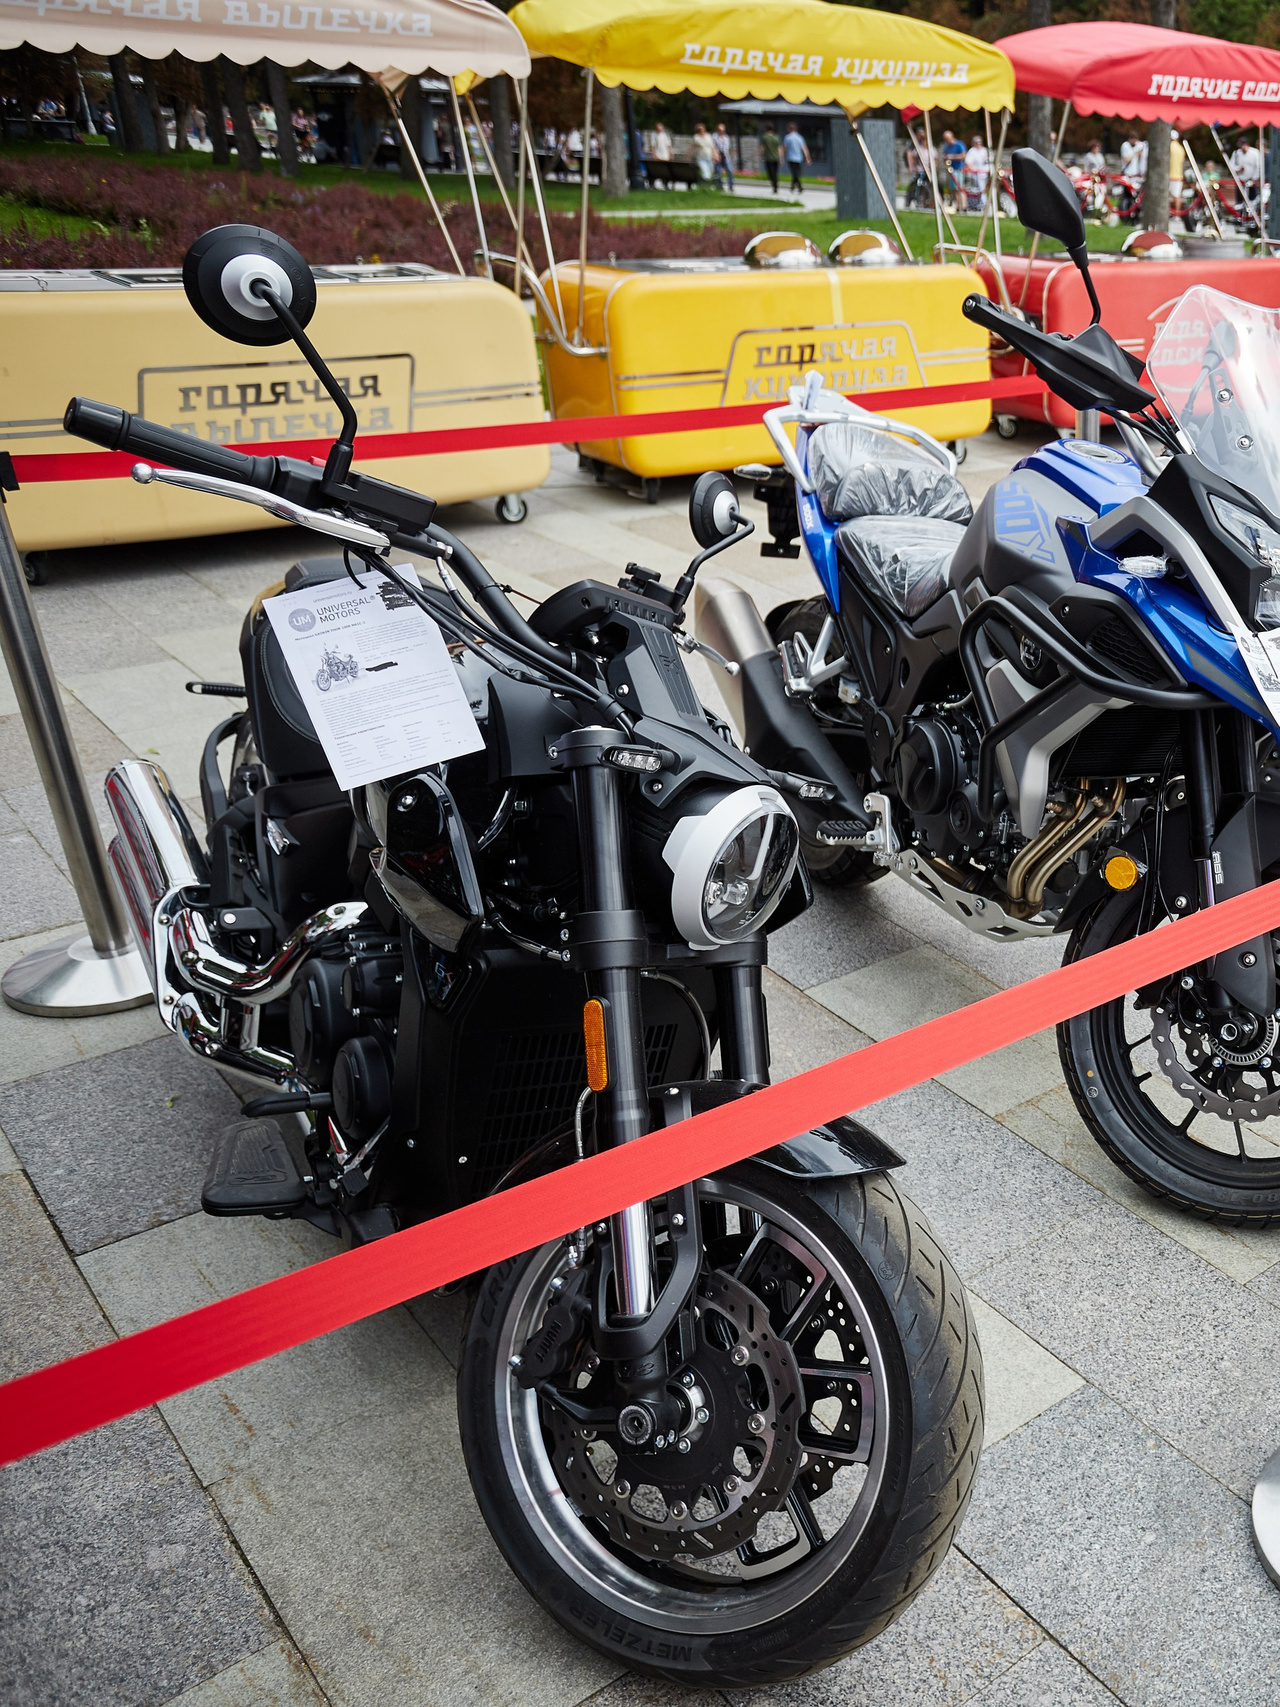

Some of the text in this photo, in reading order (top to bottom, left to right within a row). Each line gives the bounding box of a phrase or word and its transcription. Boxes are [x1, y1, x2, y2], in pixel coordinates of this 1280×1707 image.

[316, 597, 371, 616] UNIVERSAL
[319, 607, 361, 624] MOTORS
[292, 616, 312, 626] UM
[569, 1604, 693, 1663] METZELER
